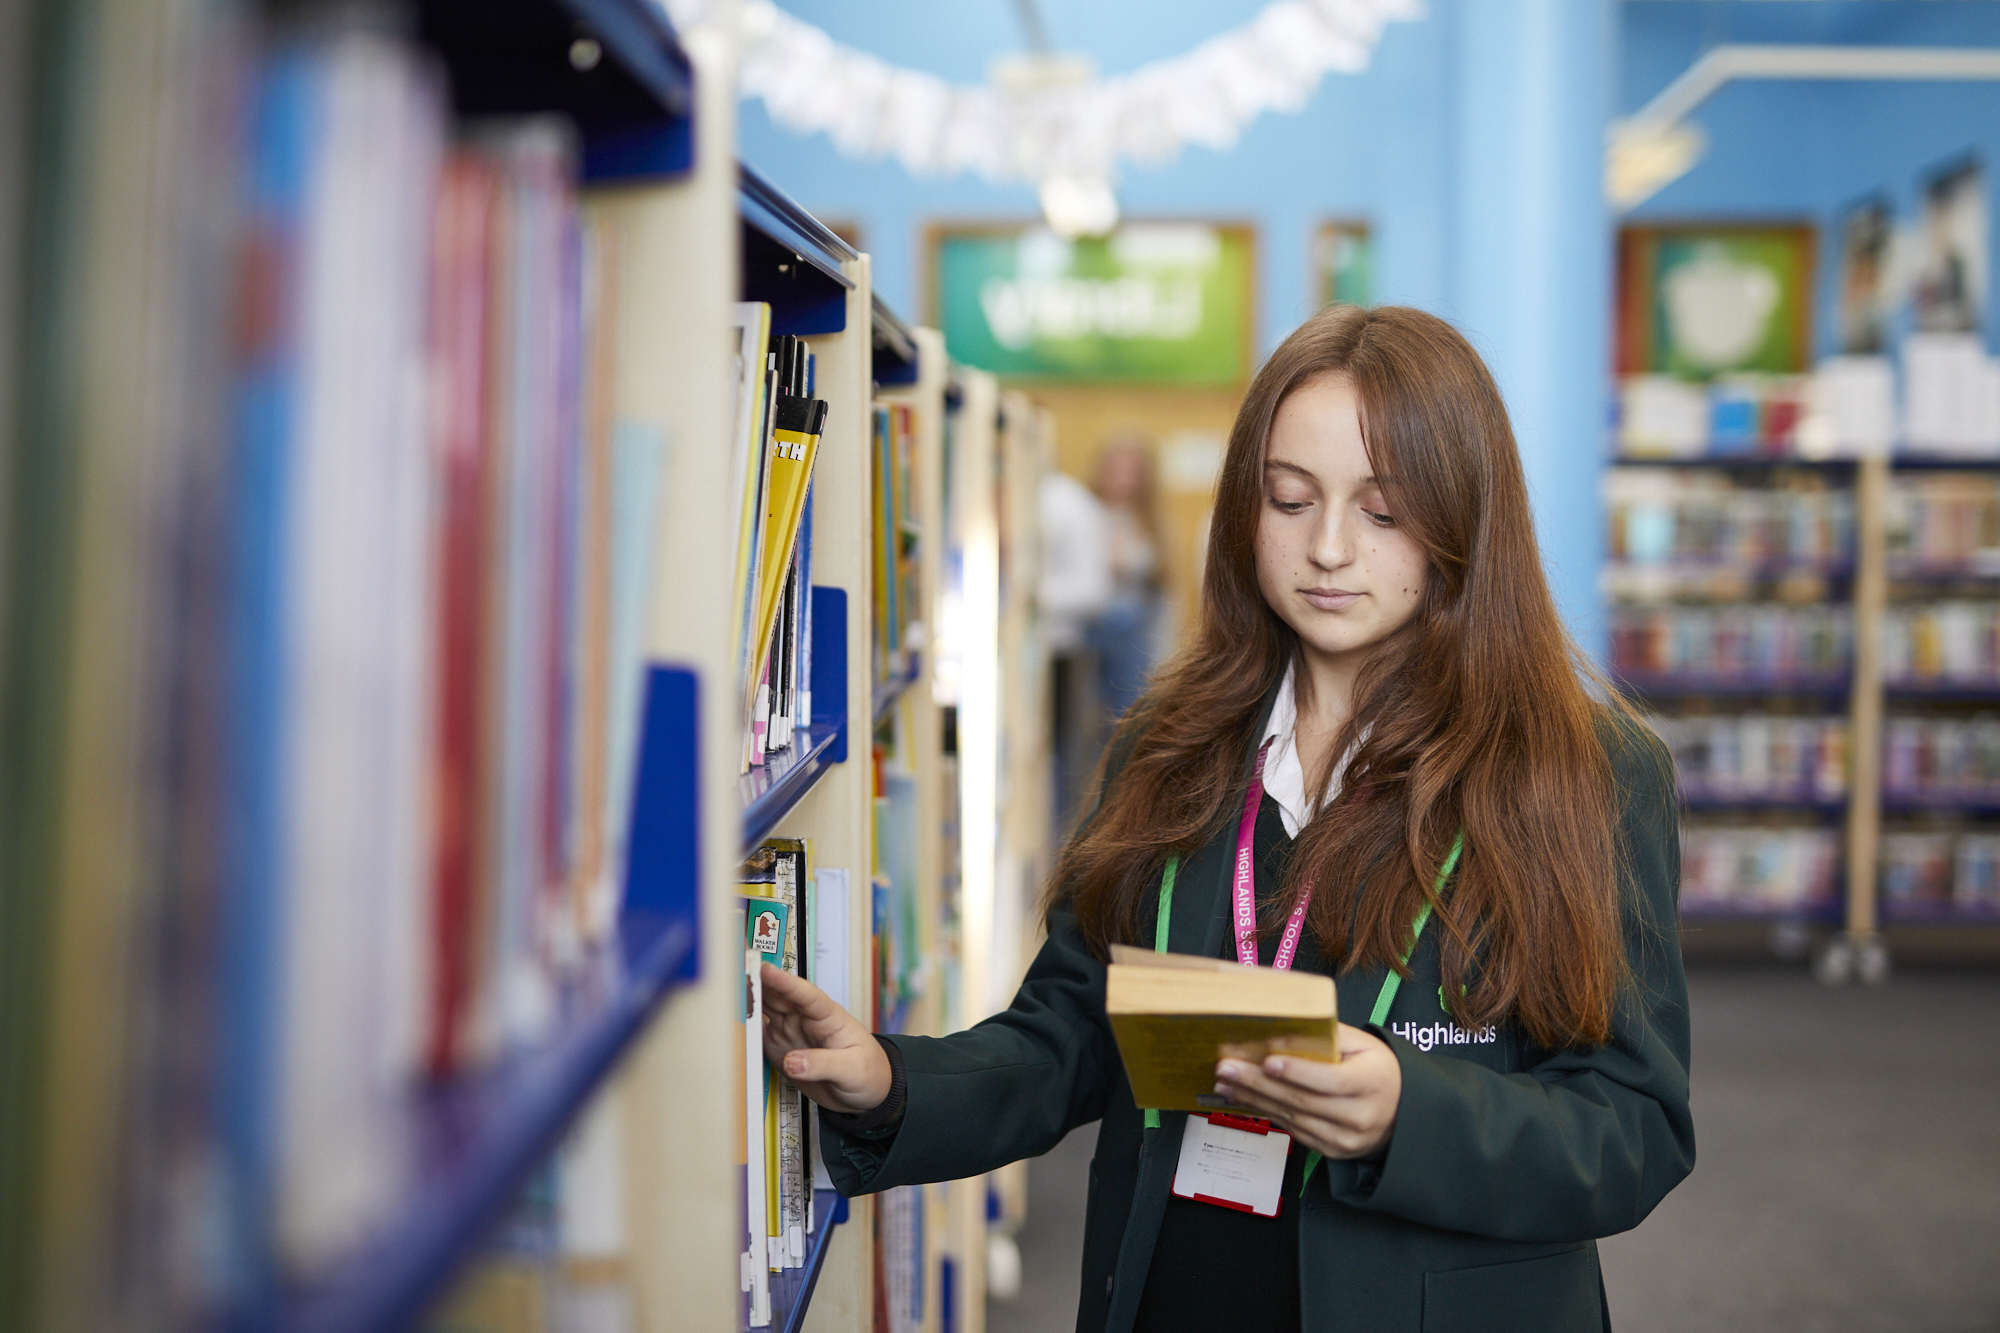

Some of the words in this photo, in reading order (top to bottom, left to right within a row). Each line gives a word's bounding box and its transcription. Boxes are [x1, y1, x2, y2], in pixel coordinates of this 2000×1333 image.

[1238, 847, 1251, 927] HIGHLANDS
[755, 938, 775, 946] WALKER
[1392, 1021, 1496, 1052] Highlands
